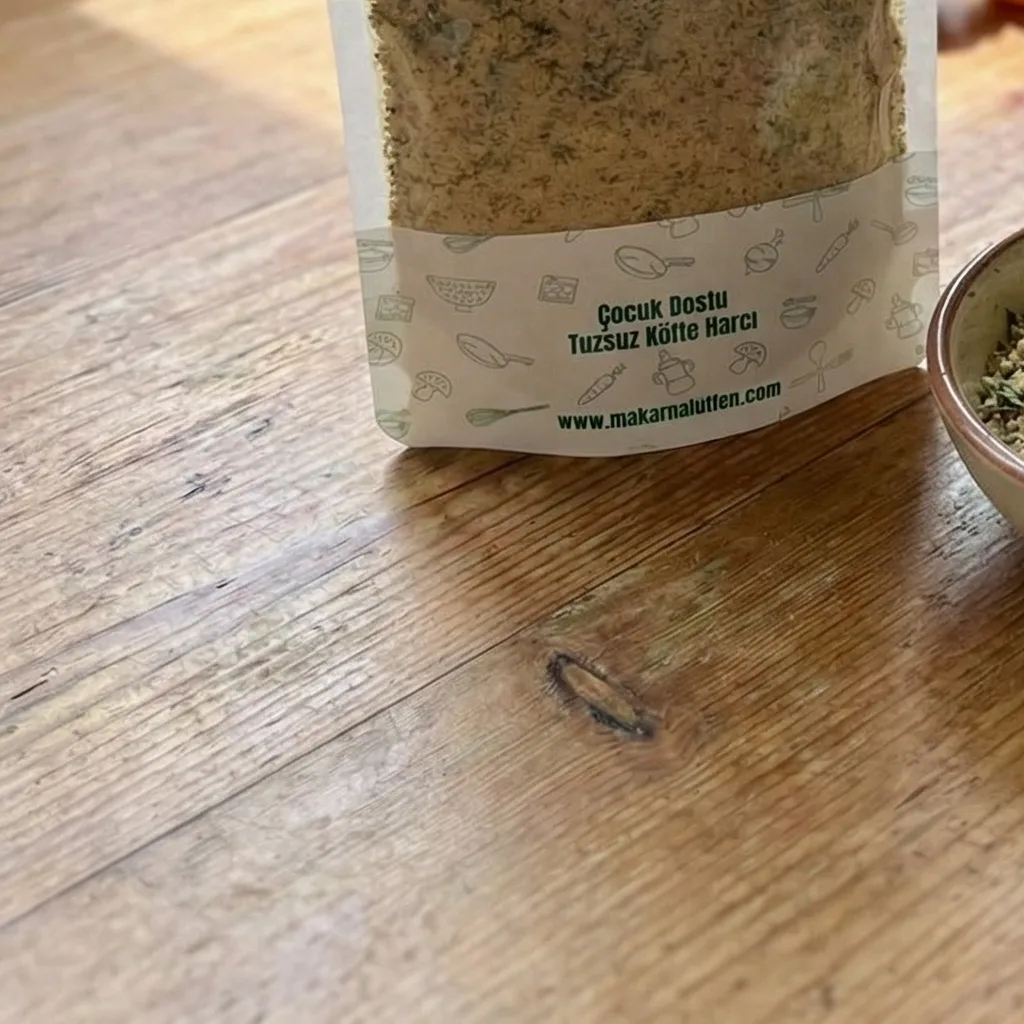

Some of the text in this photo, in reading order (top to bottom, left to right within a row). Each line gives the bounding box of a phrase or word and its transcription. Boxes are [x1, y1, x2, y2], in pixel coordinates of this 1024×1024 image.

[598, 290, 728, 332] Çocuk Dostu
[568, 311, 758, 354] Tuzsuz Köfte Harcı
